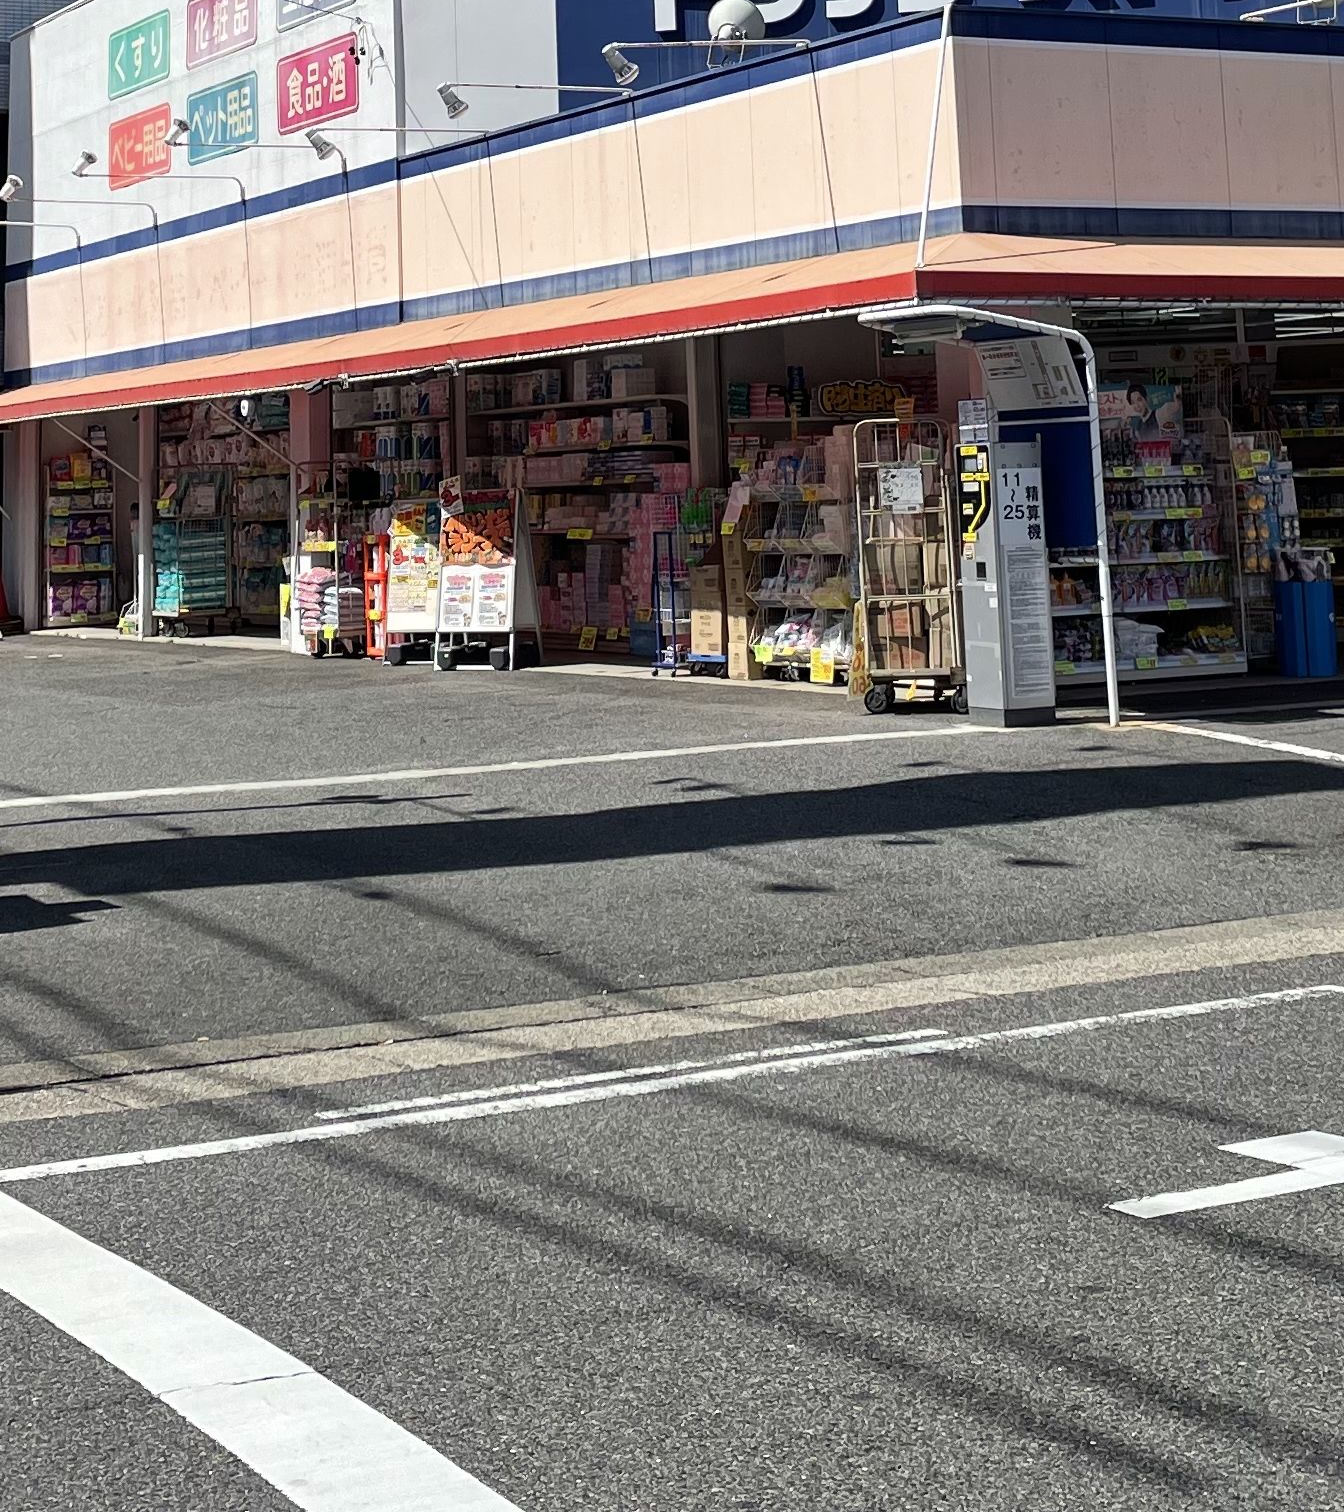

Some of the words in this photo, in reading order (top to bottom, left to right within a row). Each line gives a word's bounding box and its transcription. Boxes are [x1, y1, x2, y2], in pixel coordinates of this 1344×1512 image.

[114, 30, 164, 84] くすり
[286, 53, 346, 118] 食品・酒
[191, 88, 253, 146] ペット用品
